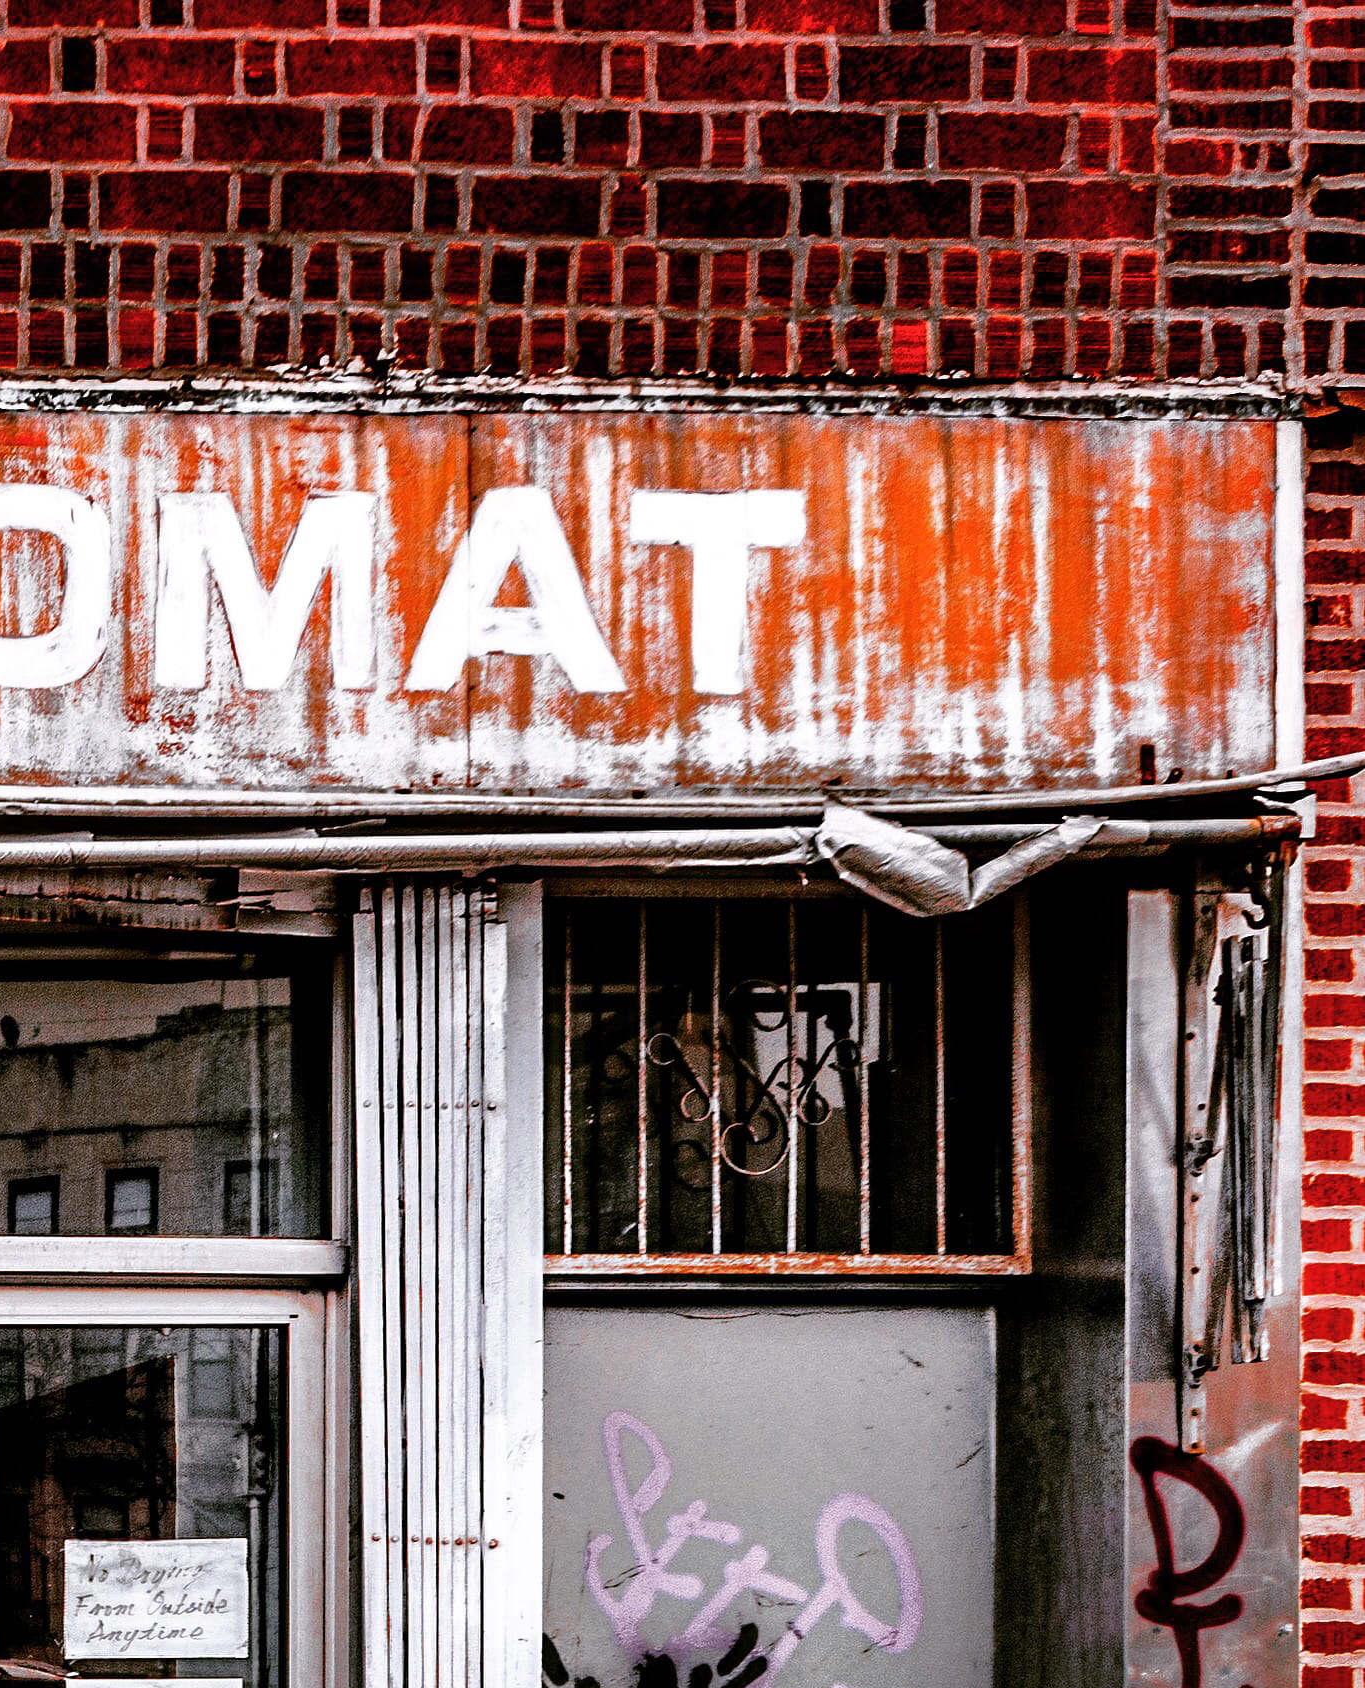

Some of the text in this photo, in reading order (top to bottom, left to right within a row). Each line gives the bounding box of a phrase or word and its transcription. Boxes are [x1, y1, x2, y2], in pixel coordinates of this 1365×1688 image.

[74, 1588, 230, 1617] From Outside
[85, 1619, 206, 1653] Anytime
